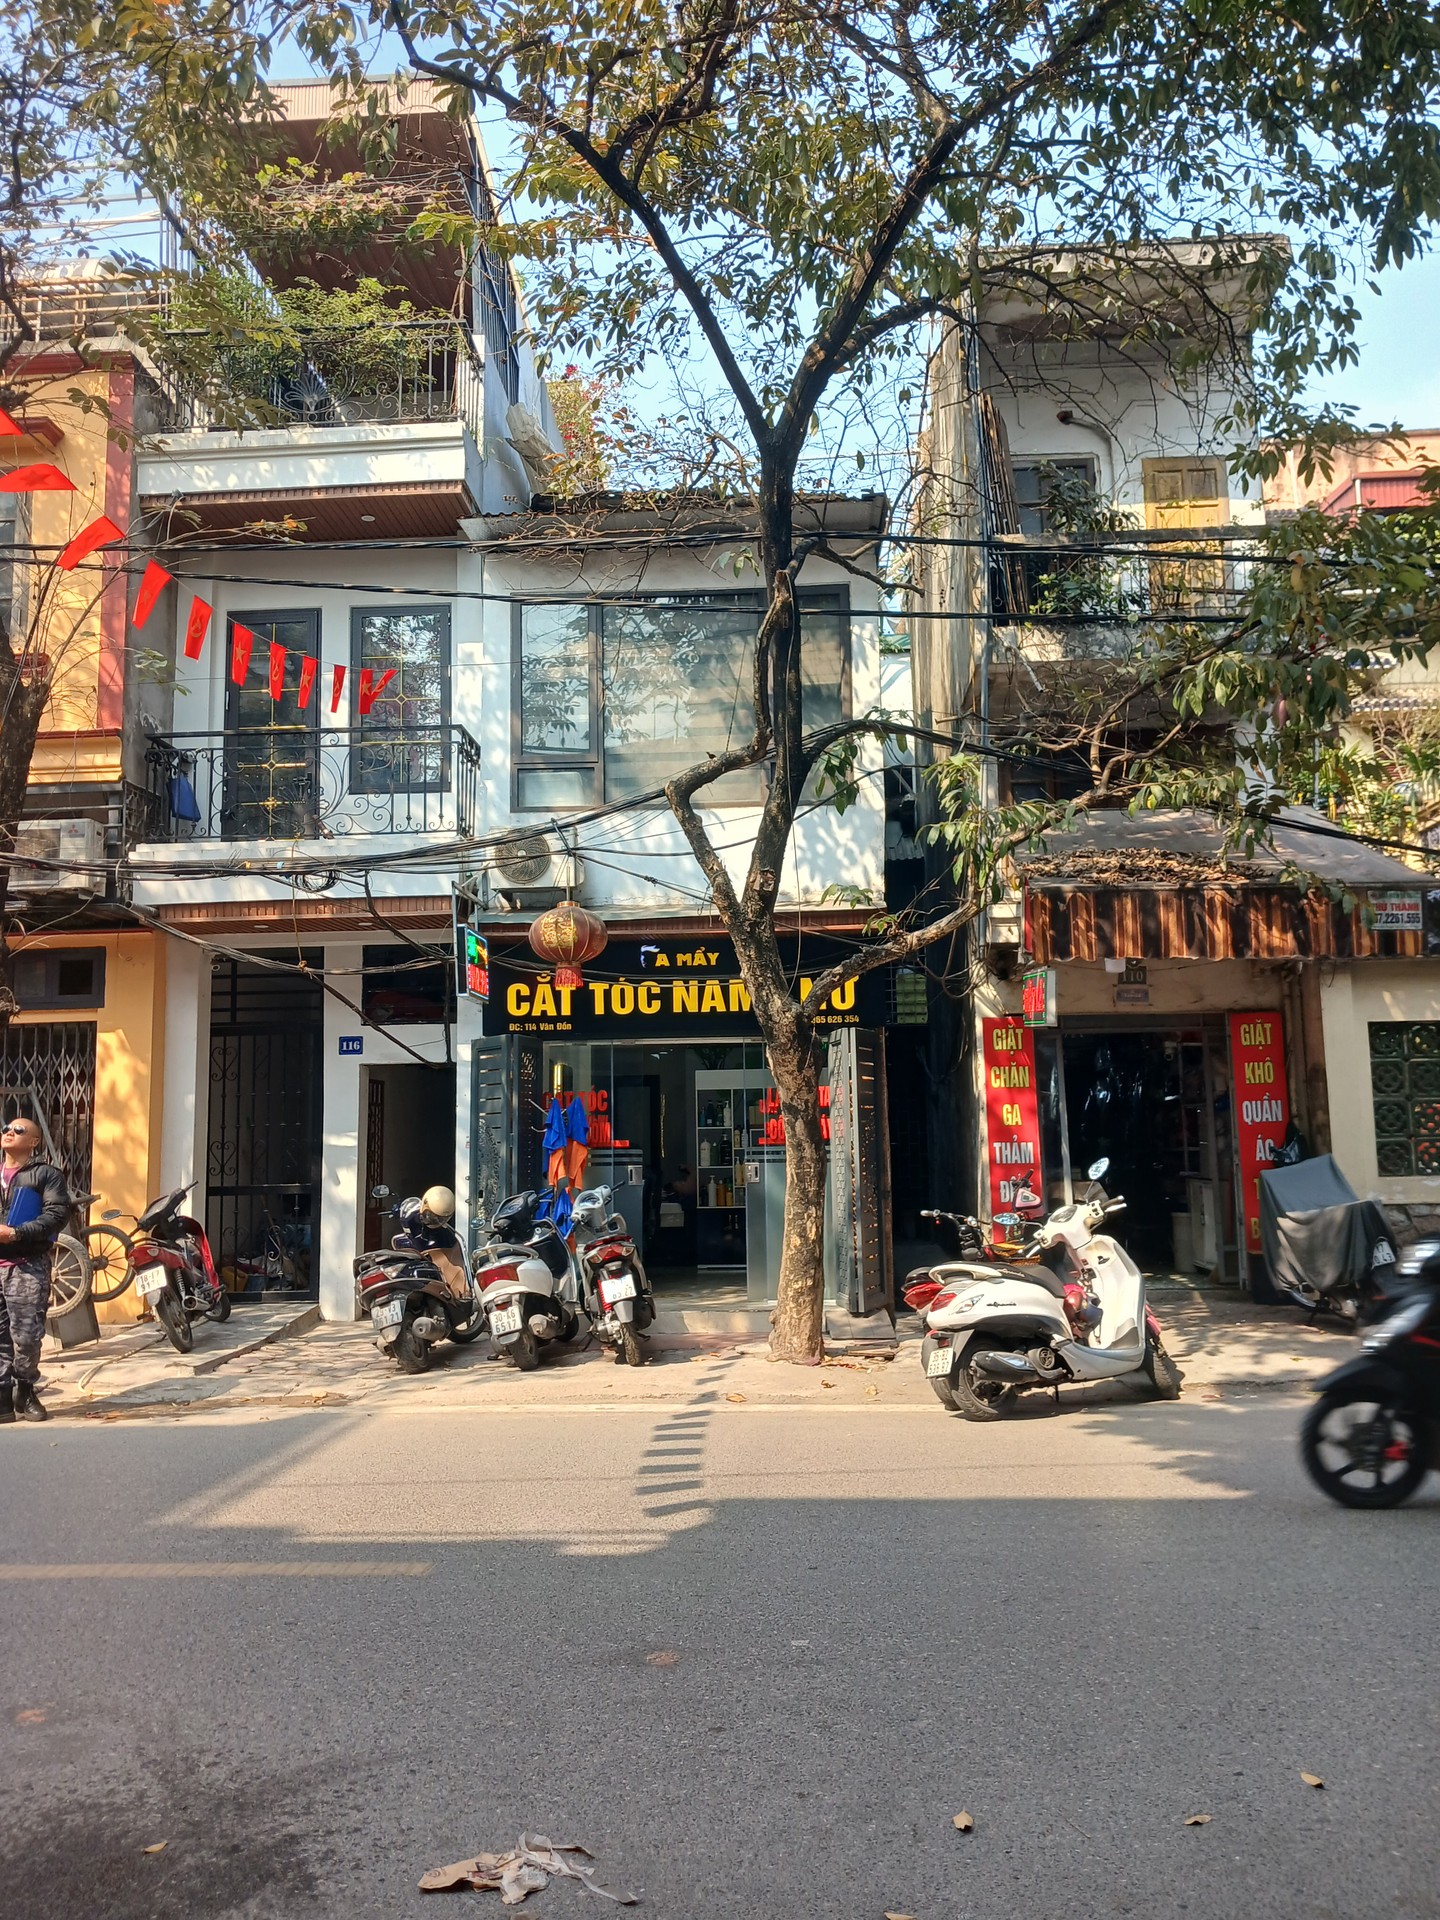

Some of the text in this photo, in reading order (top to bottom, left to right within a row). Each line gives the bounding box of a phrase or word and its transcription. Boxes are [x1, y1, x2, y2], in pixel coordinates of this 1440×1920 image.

[589, 977, 661, 1015] TÓC
[524, 1022, 537, 1031] 114
[827, 1015, 843, 1024] 626
[341, 1040, 361, 1051] 116
[992, 1024, 1024, 1055] GIẶT
[1240, 1018, 1272, 1050] GIẶT
[990, 1061, 1030, 1088] CHĂN
[1244, 1056, 1274, 1084] KHÔ
[1002, 1103, 1023, 1126] GA
[992, 1133, 1035, 1164] THẢM
[495, 1319, 517, 1334] 6517
